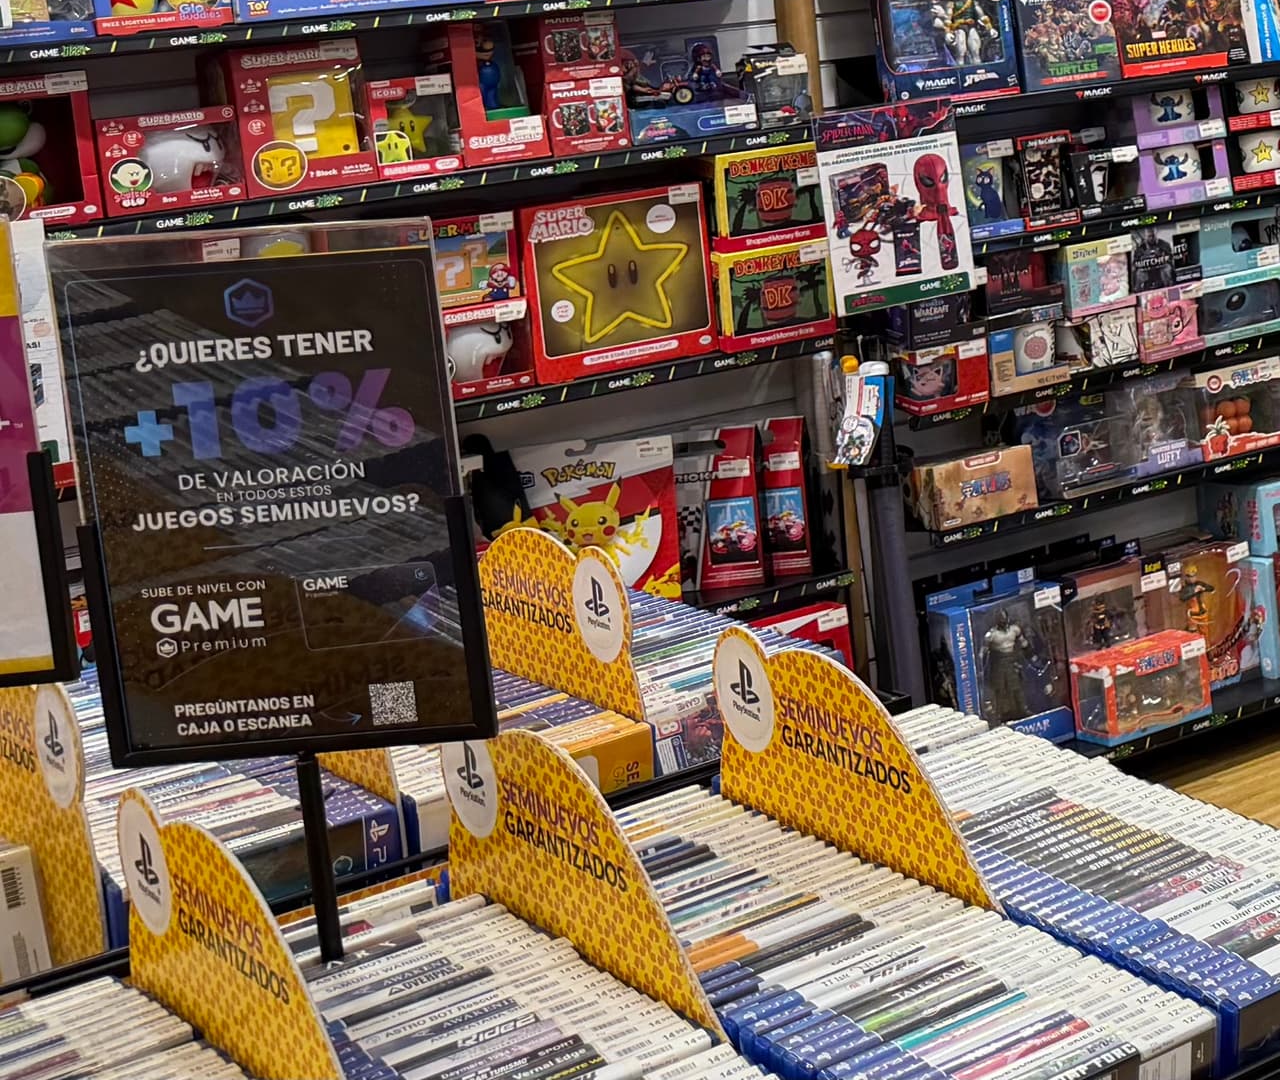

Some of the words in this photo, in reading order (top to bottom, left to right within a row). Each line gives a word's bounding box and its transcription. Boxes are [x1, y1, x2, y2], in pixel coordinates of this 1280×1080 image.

[528, 218, 595, 243] MARIO
[536, 206, 588, 226] SUPER
[135, 336, 272, 373] ¿QUIERES
[277, 329, 374, 358] TENER
[124, 368, 415, 460] +10%
[178, 473, 207, 491] DE
[212, 461, 366, 490] VALORACIÓN
[216, 490, 235, 503] EN
[239, 487, 285, 501] TODOS
[289, 484, 332, 499] ESTOS
[132, 506, 234, 534] JUEGOS
[240, 493, 420, 526] SEMINUEVOS?
[141, 585, 173, 598] SUBE
[177, 584, 193, 596] DE
[196, 581, 232, 595] NIVEL
[236, 579, 266, 592] CON
[492, 567, 569, 606] SEMINUEVOS
[150, 597, 265, 634] GAME
[480, 586, 573, 634] GARANTIZADOS
[181, 635, 267, 652] Premium
[174, 695, 290, 718] PREGÚNTANOS
[294, 694, 315, 709] EN
[177, 721, 221, 736] CAJA
[224, 719, 235, 733] O
[239, 713, 313, 732] ESCANEA
[778, 694, 885, 755] SEMINUEVOS
[781, 724, 913, 796] GARANTIZADOS
[501, 778, 600, 849] SEMINUEVOS
[503, 811, 628, 894] GARANTIZADOS
[172, 878, 265, 952] SEMINUEVOS
[177, 907, 291, 1006] GARANTIZADOS
